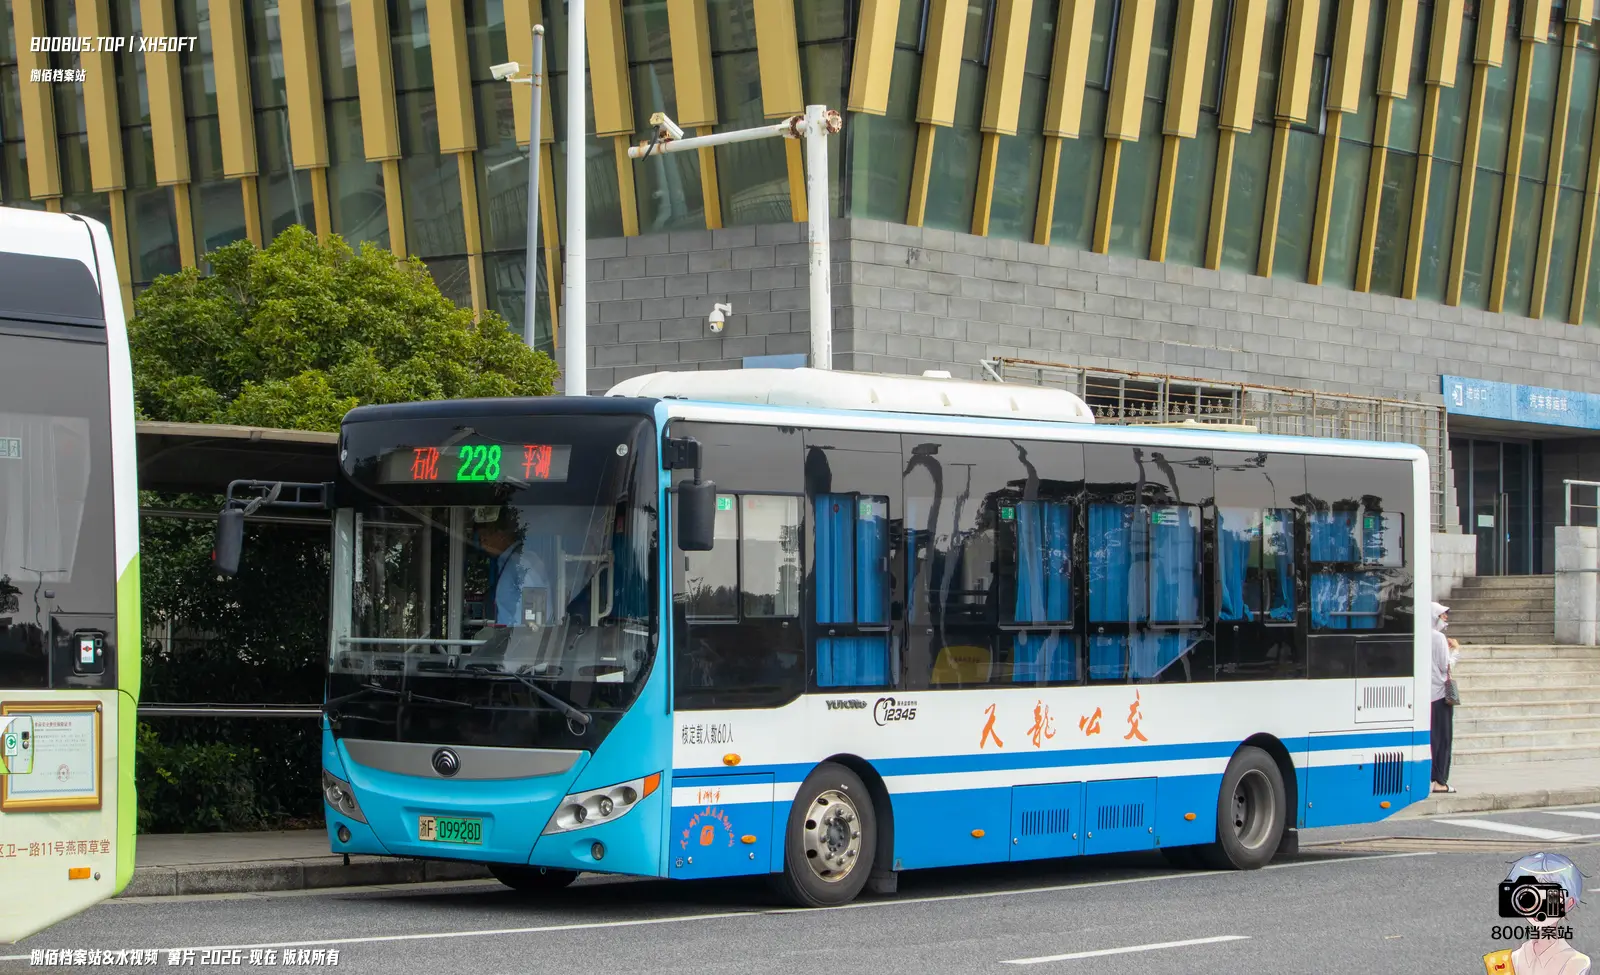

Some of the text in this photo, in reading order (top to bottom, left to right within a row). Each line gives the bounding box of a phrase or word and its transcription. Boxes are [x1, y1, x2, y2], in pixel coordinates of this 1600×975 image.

[1529, 393, 1568, 412] 汽车客运站
[410, 443, 552, 481] 石化 228 平湖
[883, 708, 917, 722] 12345
[681, 722, 734, 745] 核定载人数60人
